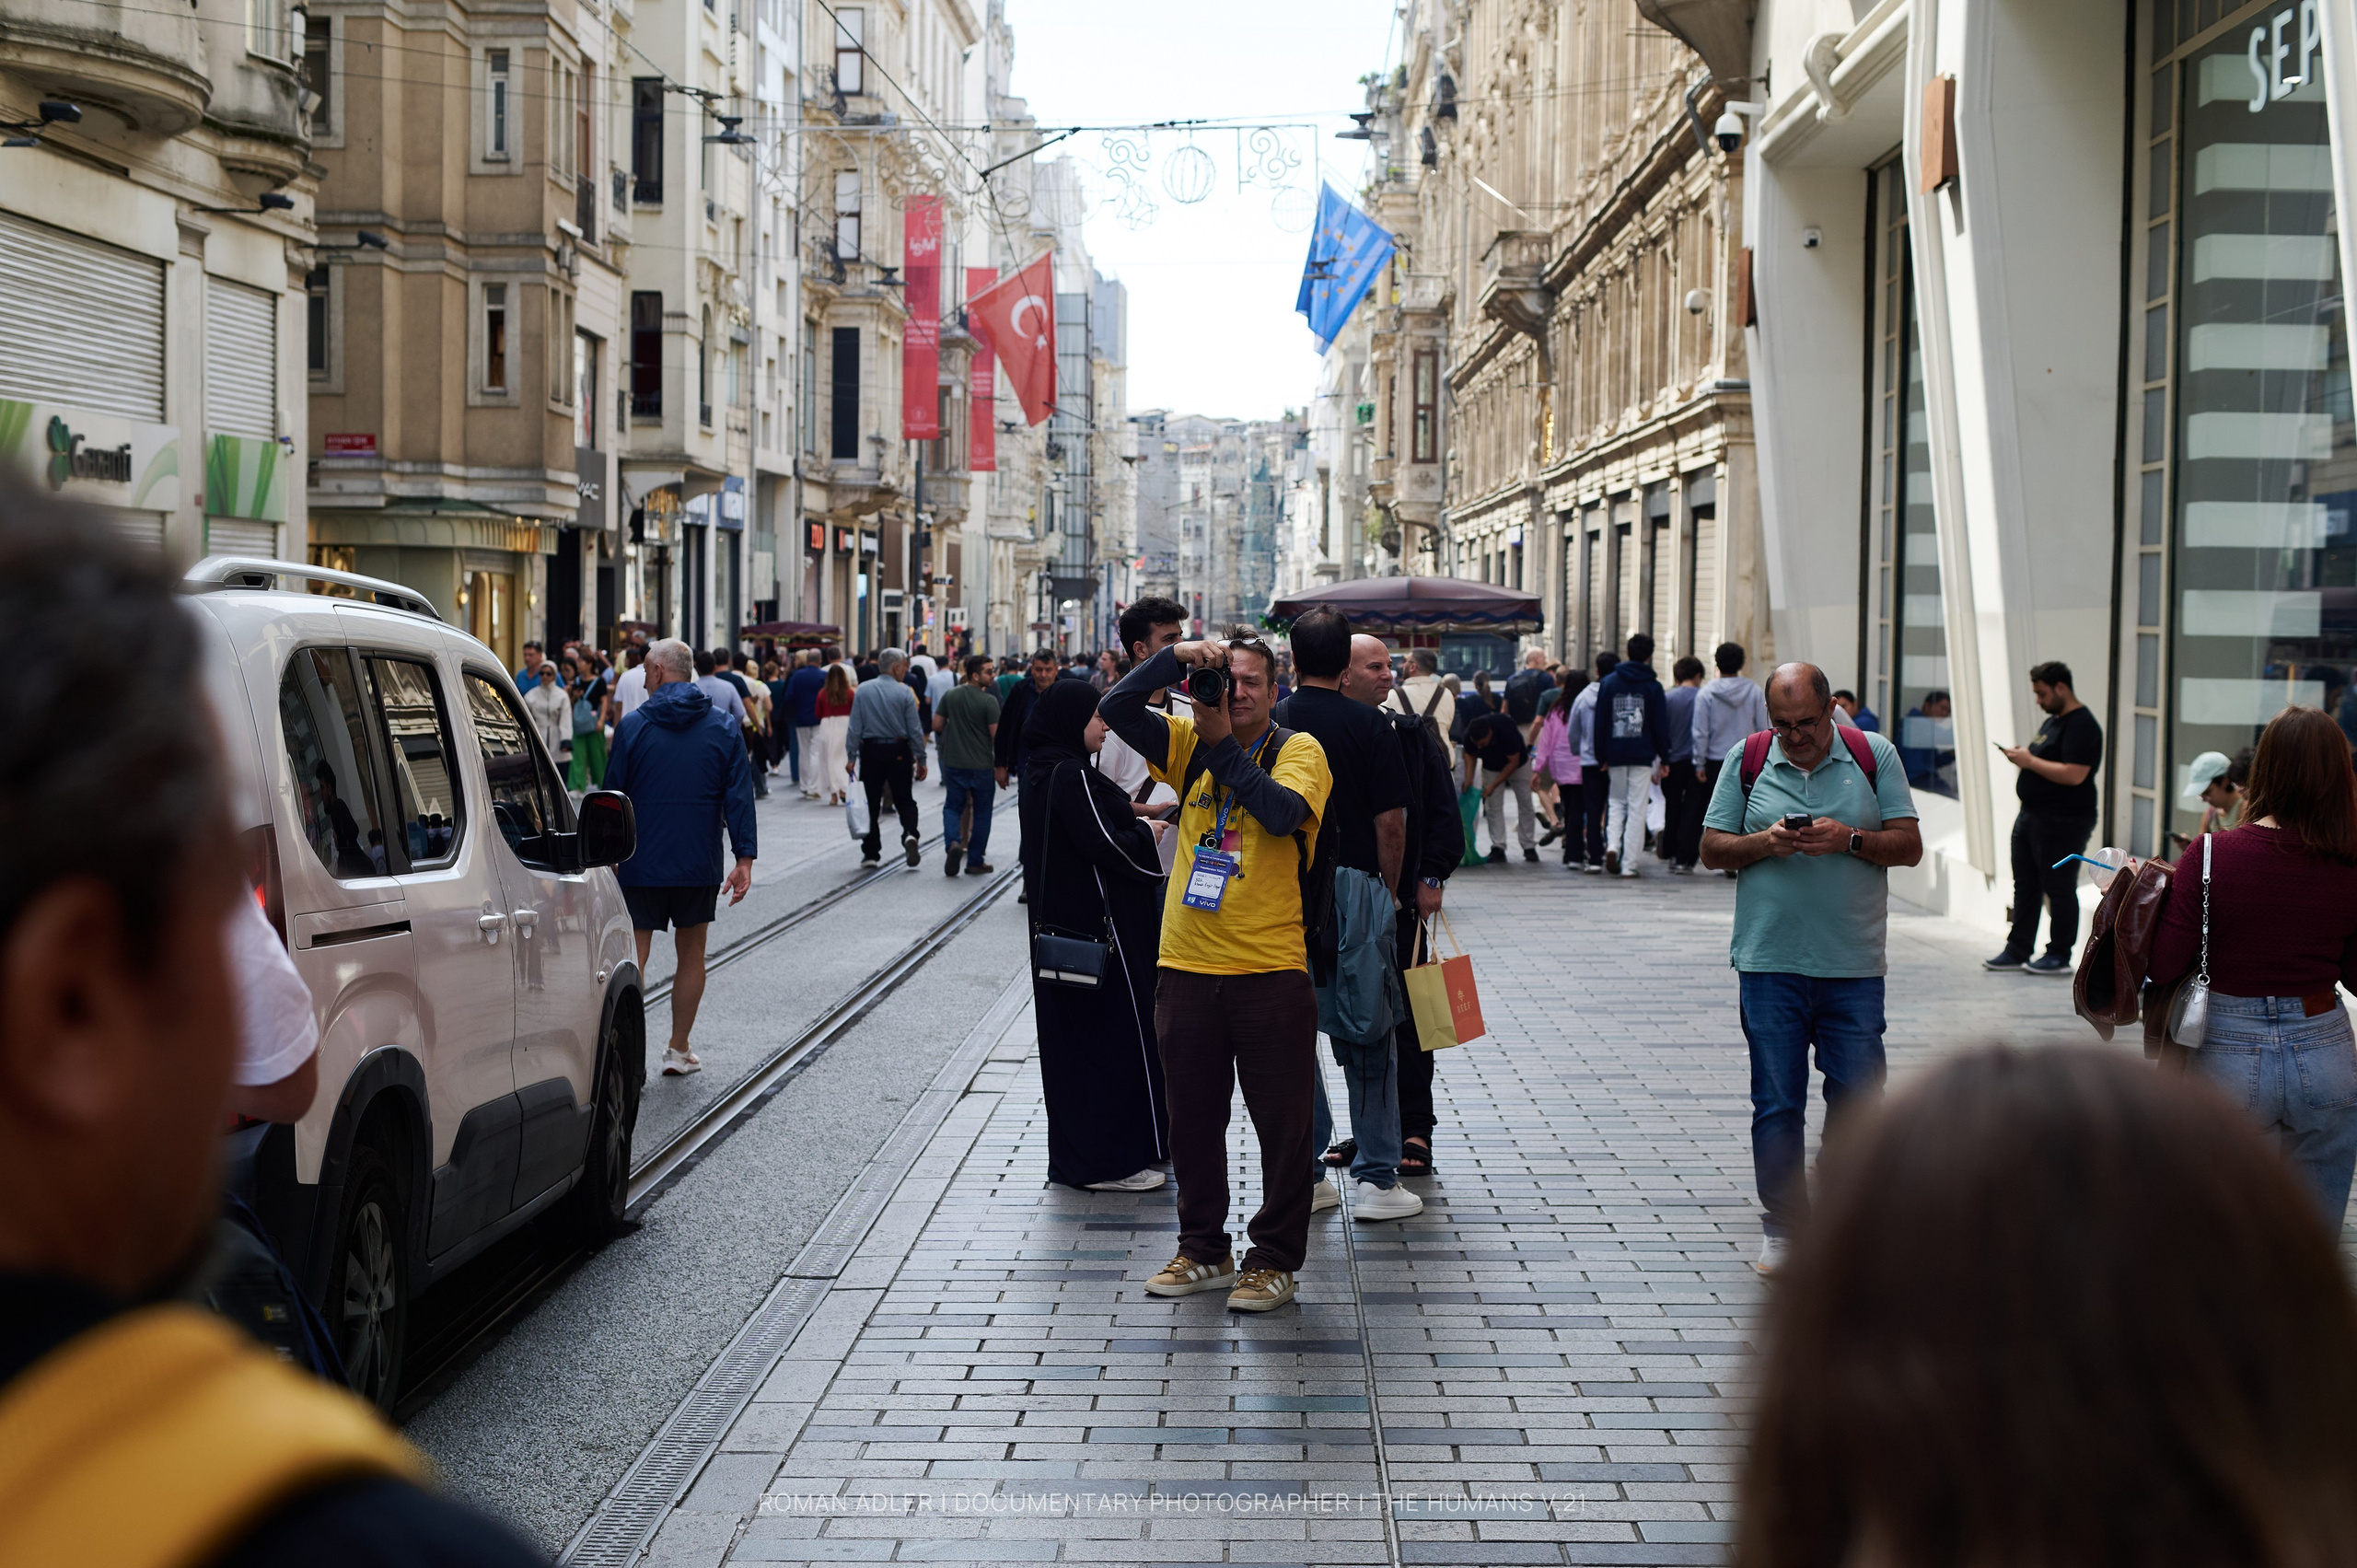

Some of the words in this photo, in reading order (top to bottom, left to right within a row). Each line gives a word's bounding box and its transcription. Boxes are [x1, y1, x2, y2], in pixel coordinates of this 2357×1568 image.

[2248, 0, 2320, 113] SEP
[69, 433, 132, 482] Garanti
[1220, 807, 1229, 826] vivo
[1199, 900, 1216, 908] vivo
[1457, 1002, 1470, 1014] REEF
